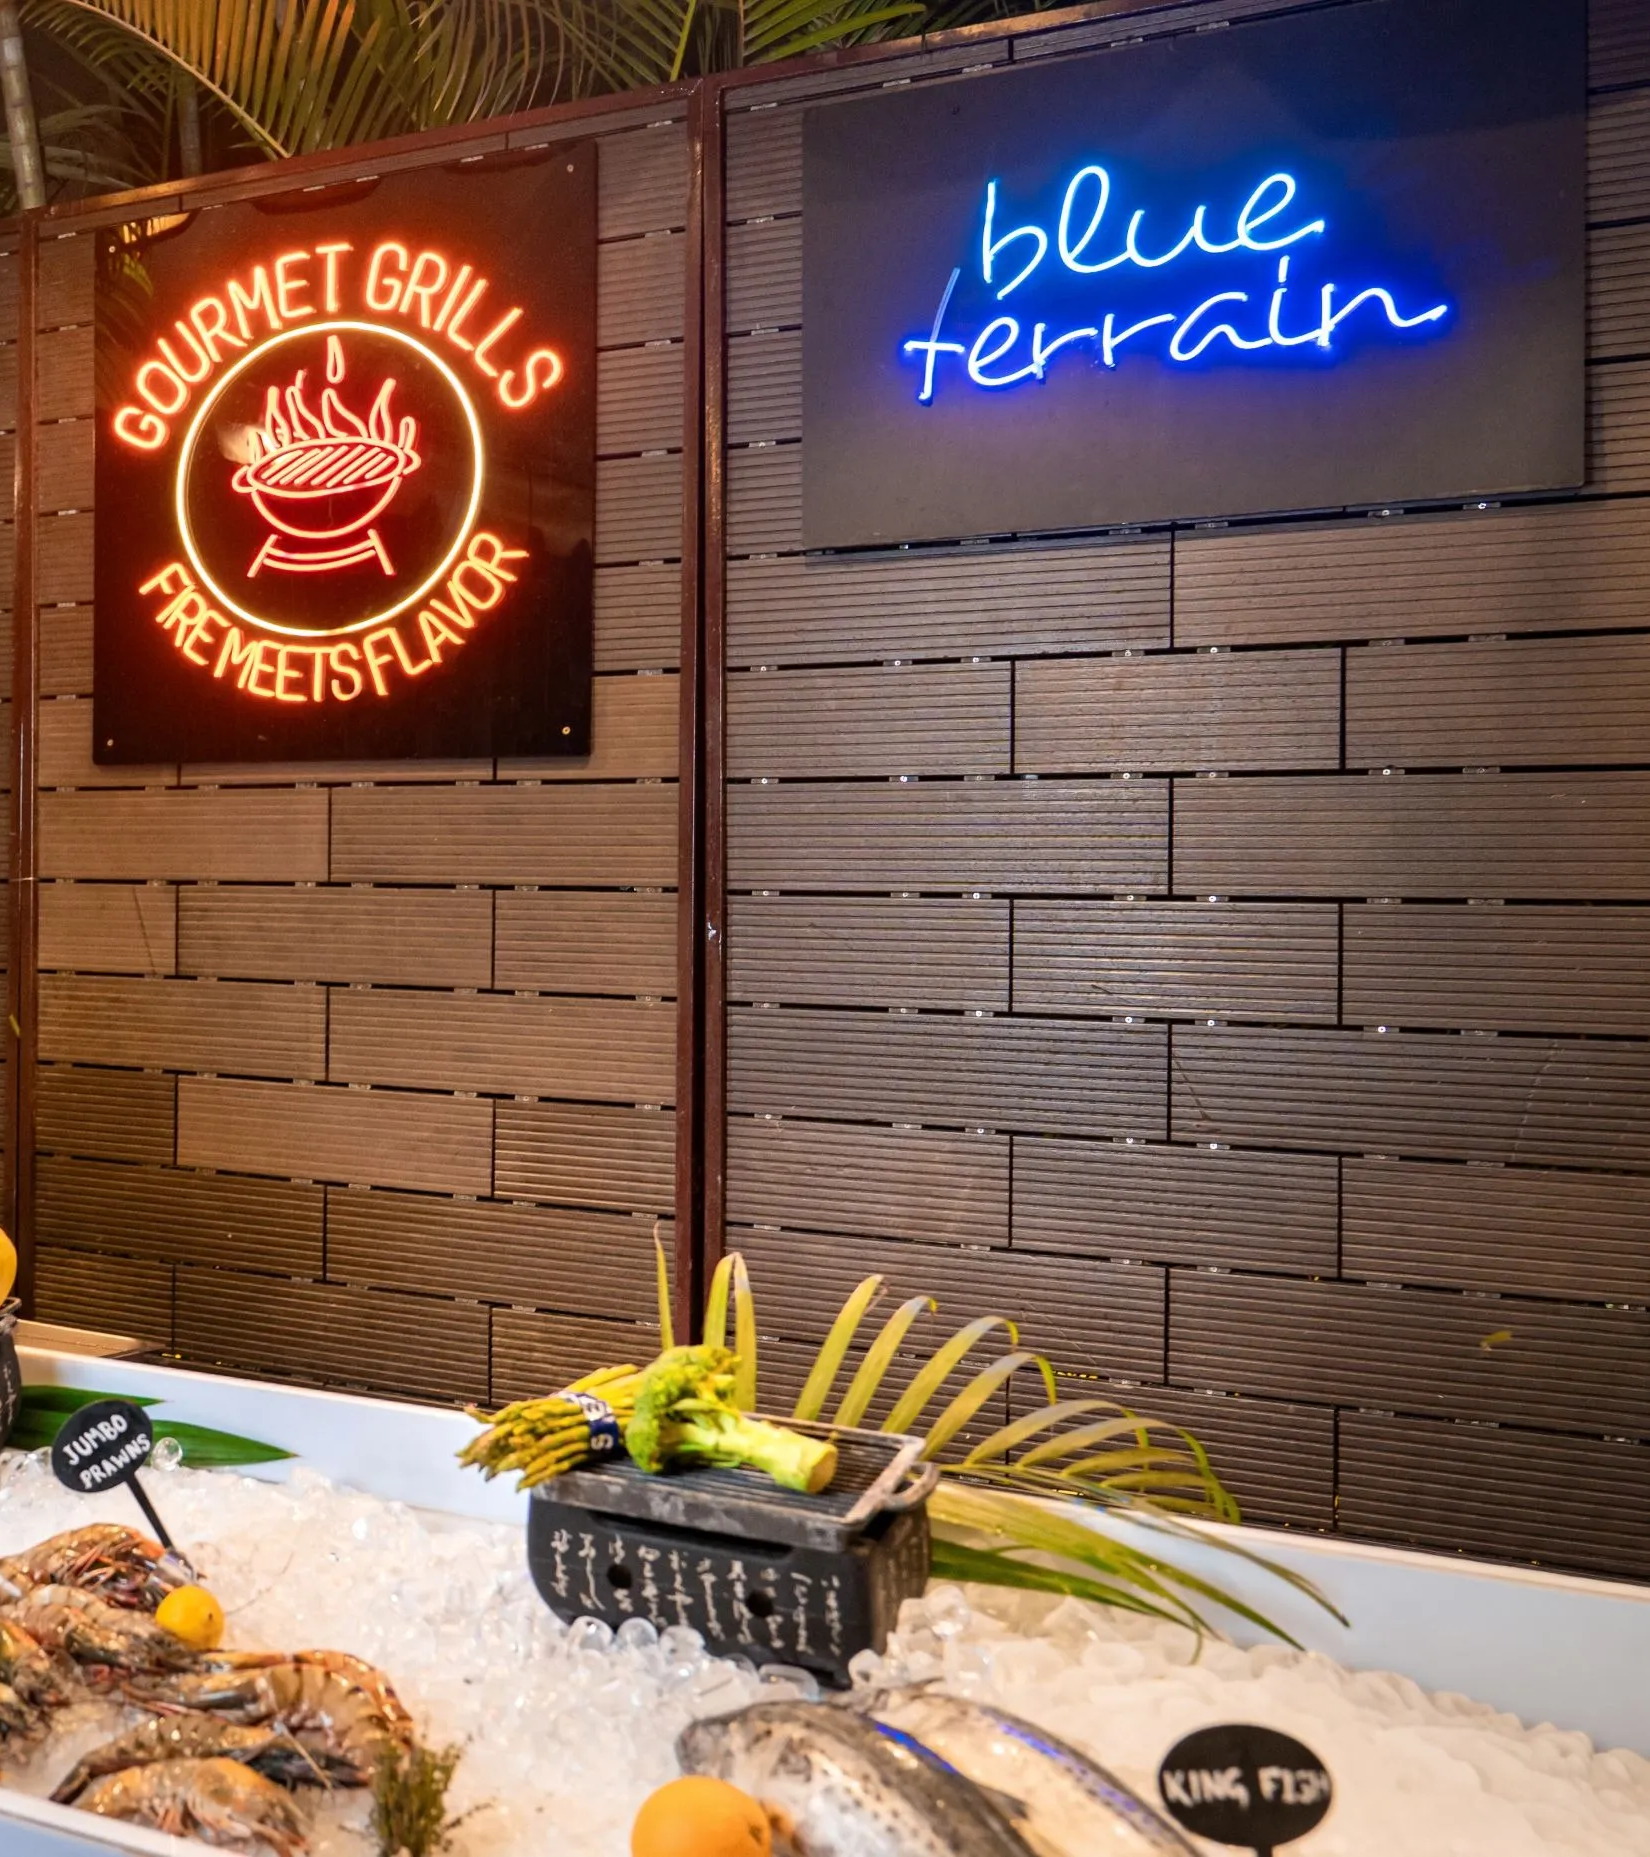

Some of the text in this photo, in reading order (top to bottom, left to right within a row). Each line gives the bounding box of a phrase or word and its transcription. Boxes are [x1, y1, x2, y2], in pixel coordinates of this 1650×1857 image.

[982, 164, 1326, 301] blue
[112, 240, 563, 450] GOURMET GRILLS
[902, 254, 1448, 405] terrain
[62, 1413, 128, 1466] JUMBO
[78, 1432, 151, 1490] PRAWNS
[1162, 1766, 1250, 1809] KING
